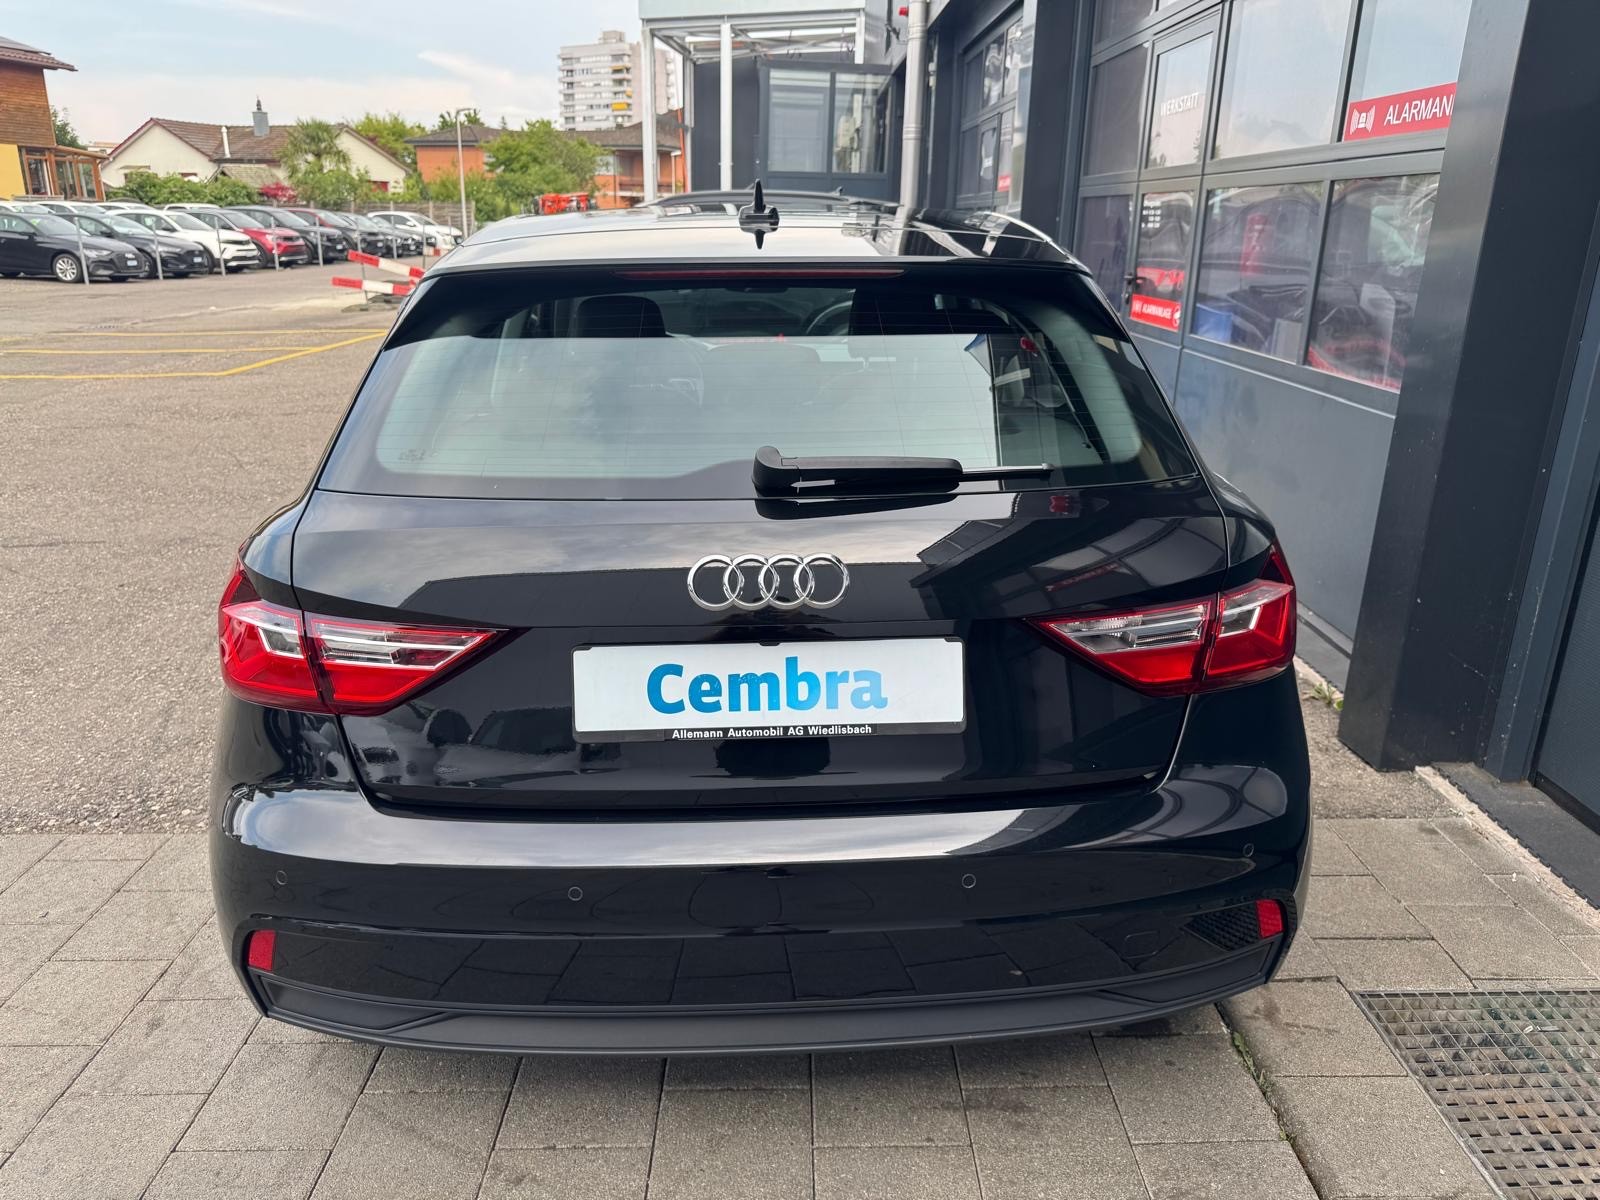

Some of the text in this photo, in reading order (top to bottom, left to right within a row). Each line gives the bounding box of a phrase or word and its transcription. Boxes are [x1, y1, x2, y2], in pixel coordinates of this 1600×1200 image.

[1160, 92, 1199, 116] WERKSTATT
[646, 656, 888, 715] Cembra
[672, 724, 872, 739] Allemann Automobil AG Wiedlisbach
